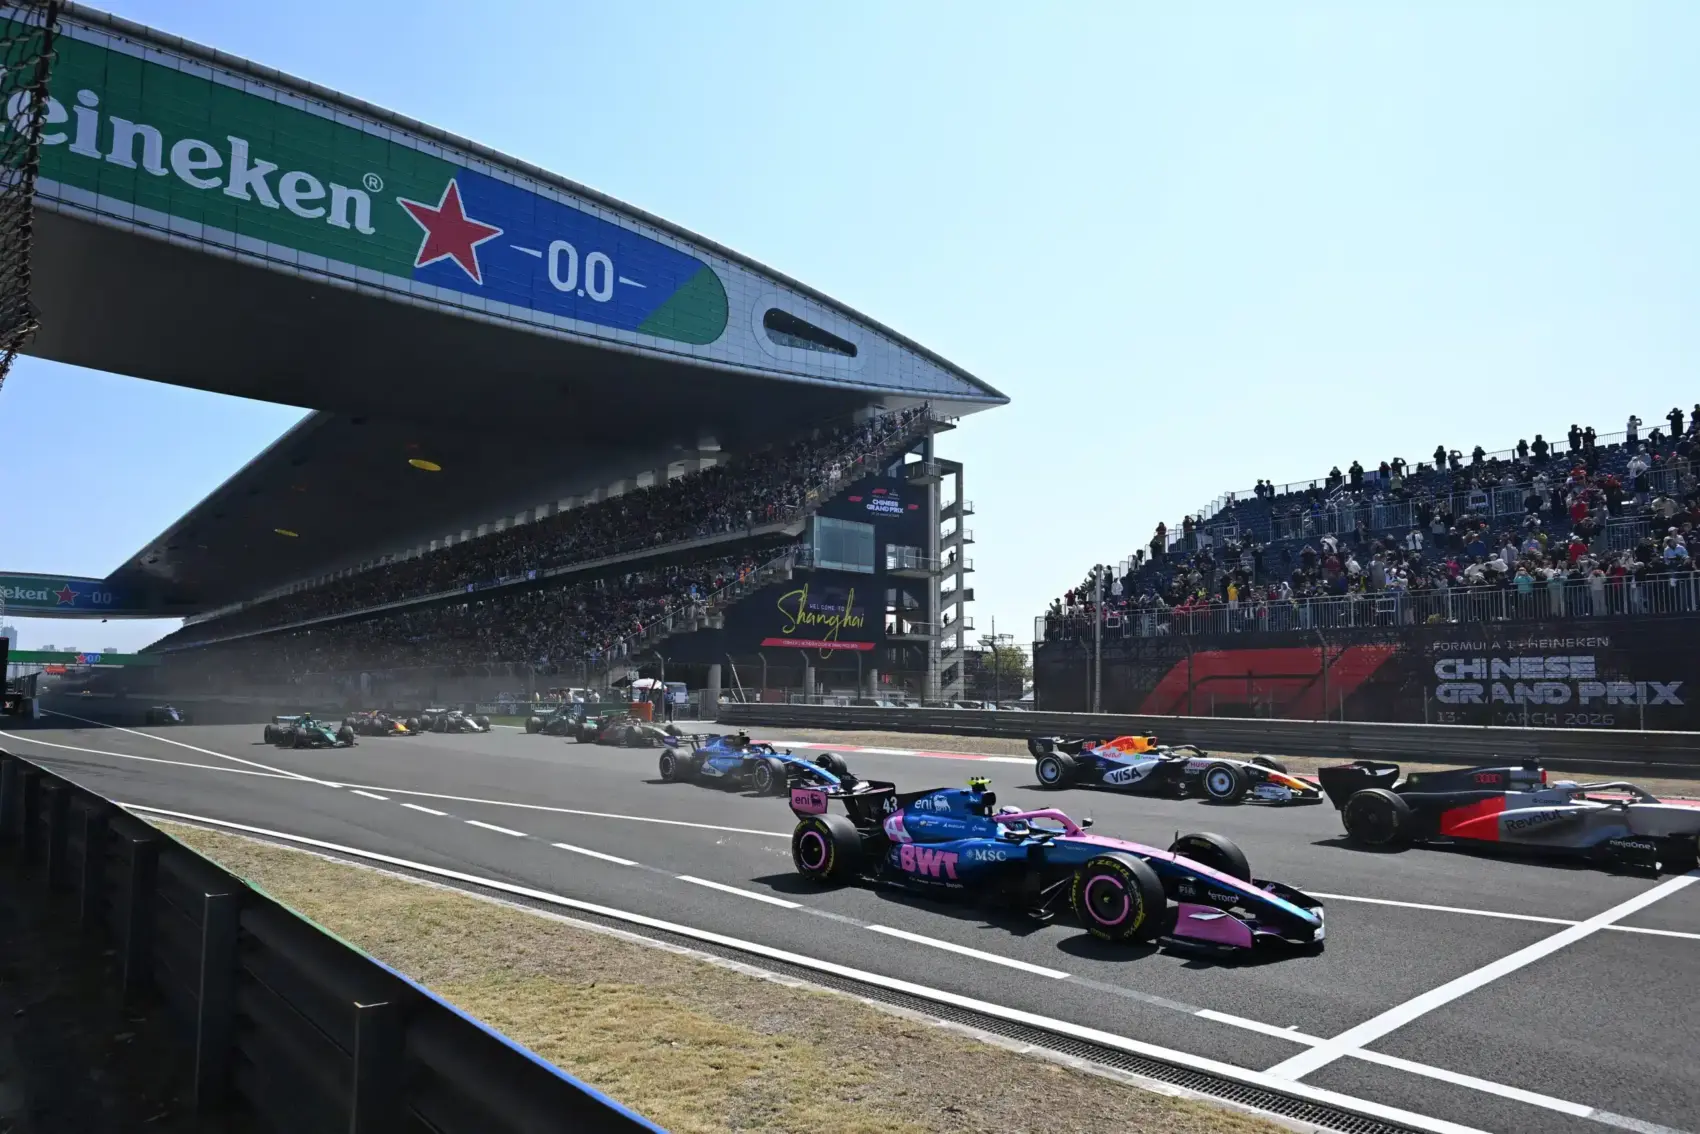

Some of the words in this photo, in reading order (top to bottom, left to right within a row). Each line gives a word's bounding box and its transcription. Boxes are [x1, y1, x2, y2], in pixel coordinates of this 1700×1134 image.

[0, 88, 376, 234] eineken
[866, 503, 889, 512] GRAND
[889, 506, 904, 514] PRIX
[872, 499, 899, 507] CHINESE
[809, 603, 834, 611] WELCOME
[777, 583, 865, 659] Shanghai
[1528, 637, 1609, 649] HEINEKEN
[1434, 655, 1596, 680] CHINESE
[1435, 681, 1572, 705] GRAND
[1578, 680, 1685, 705] PRIX
[1497, 711, 1558, 725] ARCH
[1564, 713, 1615, 725] 2026
[1110, 767, 1142, 783] VISA
[795, 794, 810, 804] eni
[882, 796, 898, 813] 43
[914, 796, 933, 810] eni
[1505, 809, 1561, 832] Revolut
[1609, 839, 1651, 850] ninjaOne
[901, 843, 958, 880] BWT
[975, 848, 1007, 861] MSC
[1179, 885, 1196, 895] FIA
